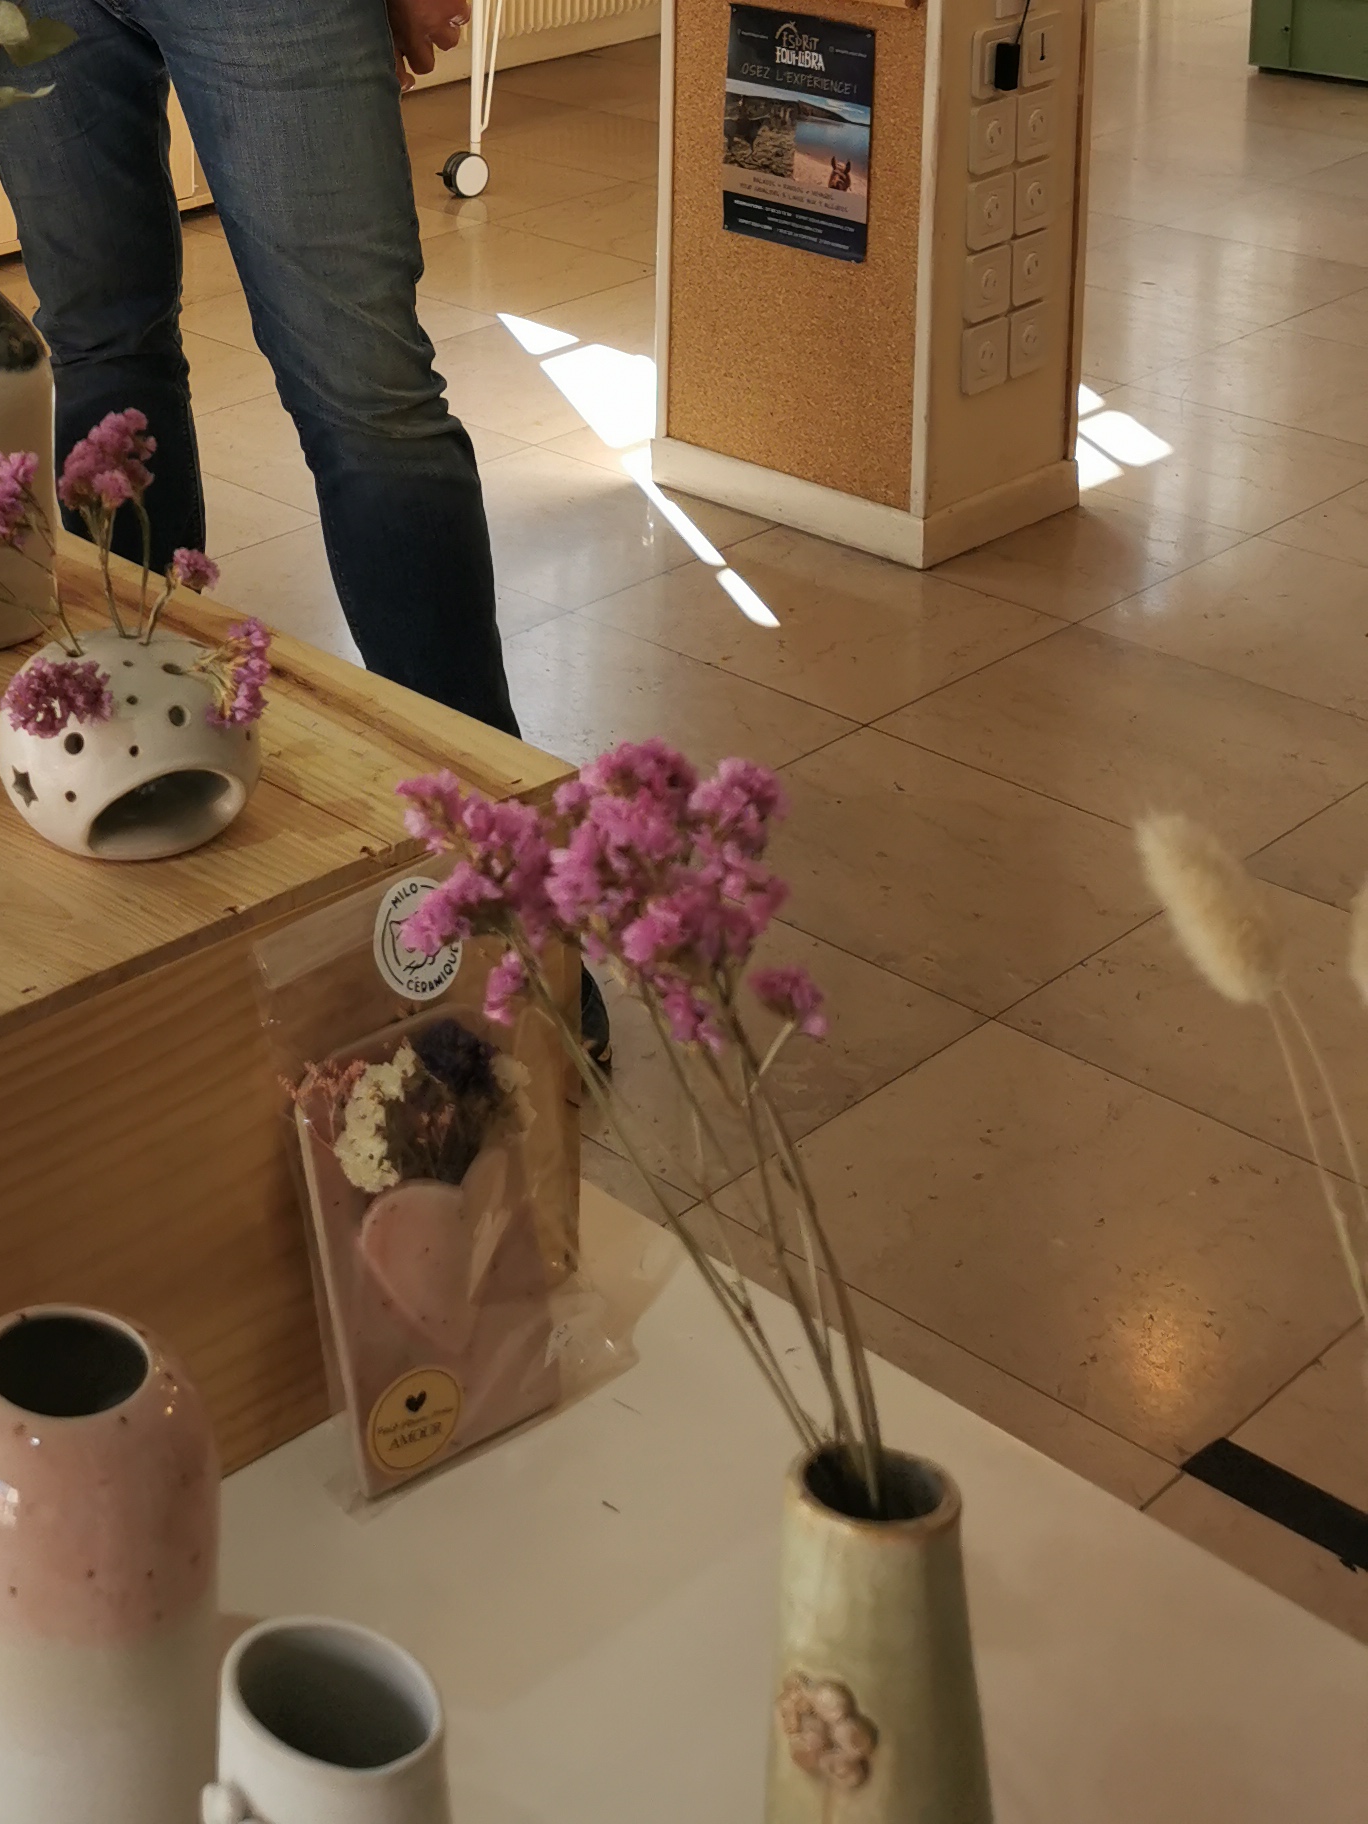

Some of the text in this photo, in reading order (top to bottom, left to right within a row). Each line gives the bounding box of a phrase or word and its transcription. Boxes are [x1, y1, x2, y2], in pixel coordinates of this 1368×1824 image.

[741, 63, 772, 80] OSEZ
[391, 882, 419, 910] MILO
[406, 944, 460, 994] CÉRAMIQUE
